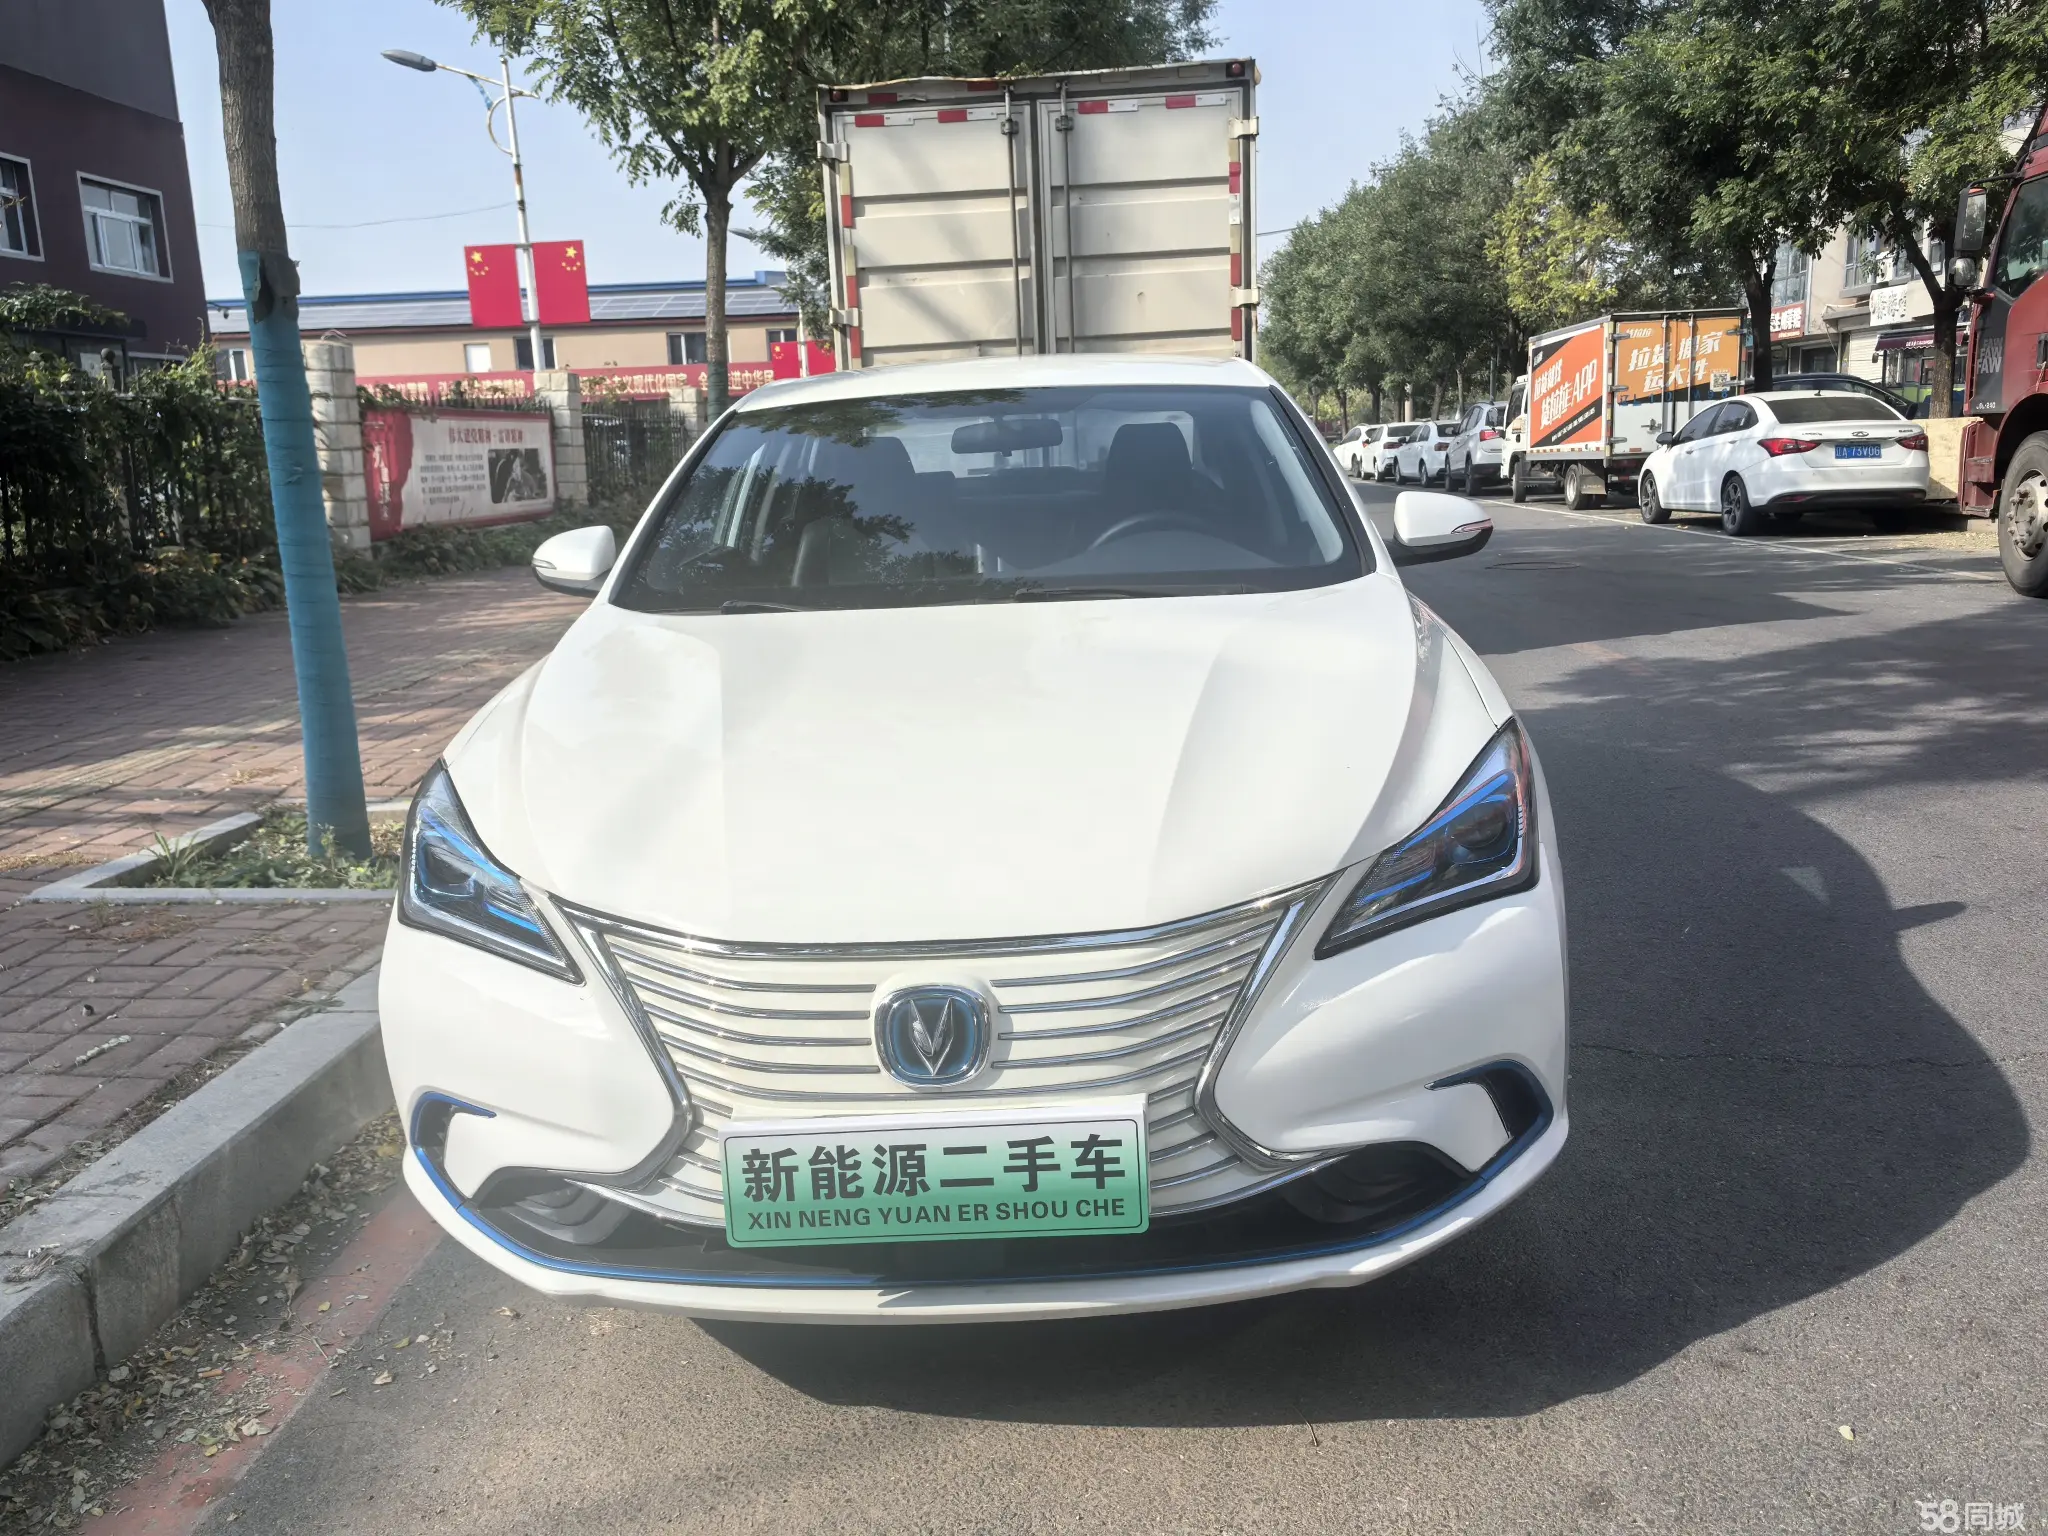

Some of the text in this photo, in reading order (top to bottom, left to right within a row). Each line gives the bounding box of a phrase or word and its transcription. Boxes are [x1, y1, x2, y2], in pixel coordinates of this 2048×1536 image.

[1984, 337, 2003, 348] FAW
[1980, 347, 2003, 359] FAW
[1977, 357, 2002, 374] FAW
[742, 1133, 1126, 1203] 新能源二手车
[748, 1198, 1125, 1230] XIN NENG YUAN ER SHOU CHE
